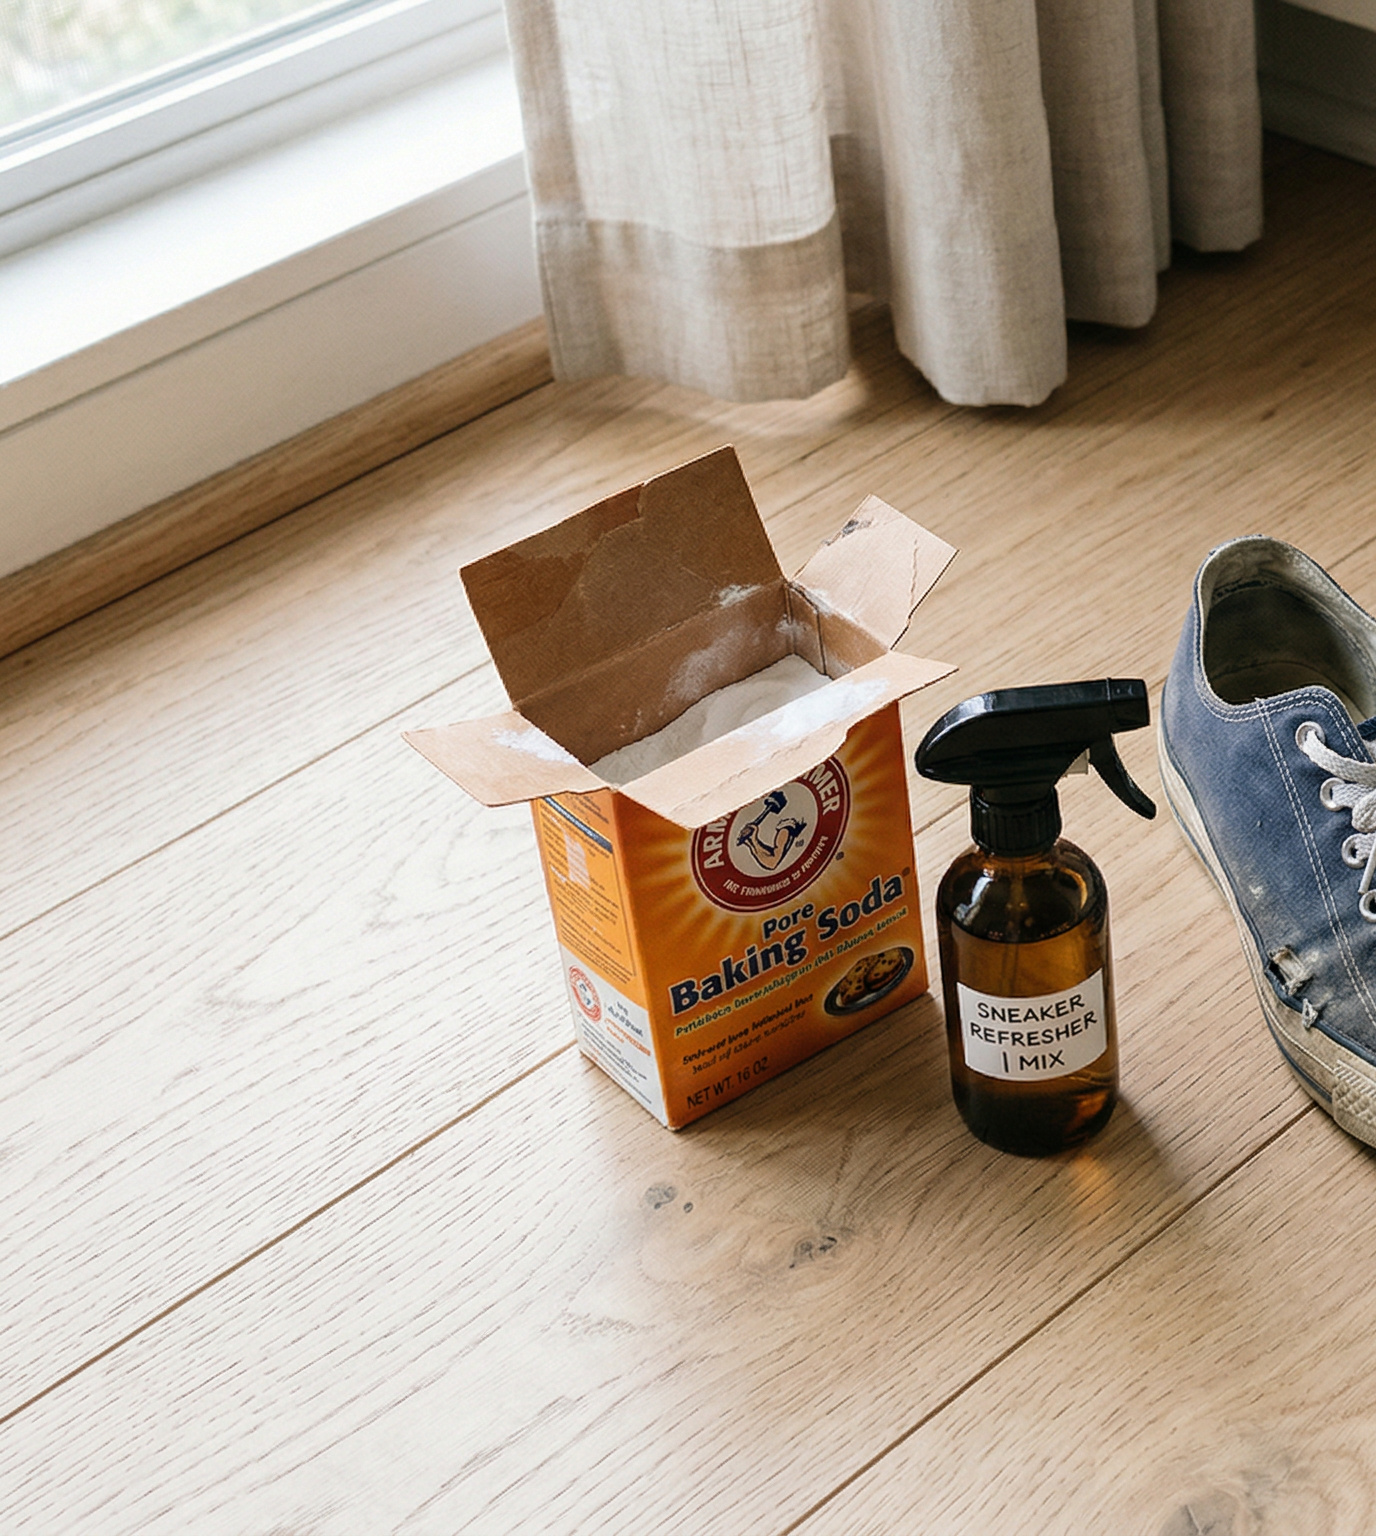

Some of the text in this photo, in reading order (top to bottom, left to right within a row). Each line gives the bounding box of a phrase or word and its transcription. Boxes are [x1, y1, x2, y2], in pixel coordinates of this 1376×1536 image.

[803, 764, 841, 816] MER
[763, 903, 814, 940] Pore
[670, 929, 806, 1015] Baking
[818, 874, 903, 940] Soda
[977, 994, 1085, 1023] SNEAKER
[970, 1011, 1098, 1047] REFRESHER
[1019, 1050, 1065, 1071] MIX
[686, 1086, 710, 1109] NET
[737, 1066, 751, 1084] 16
